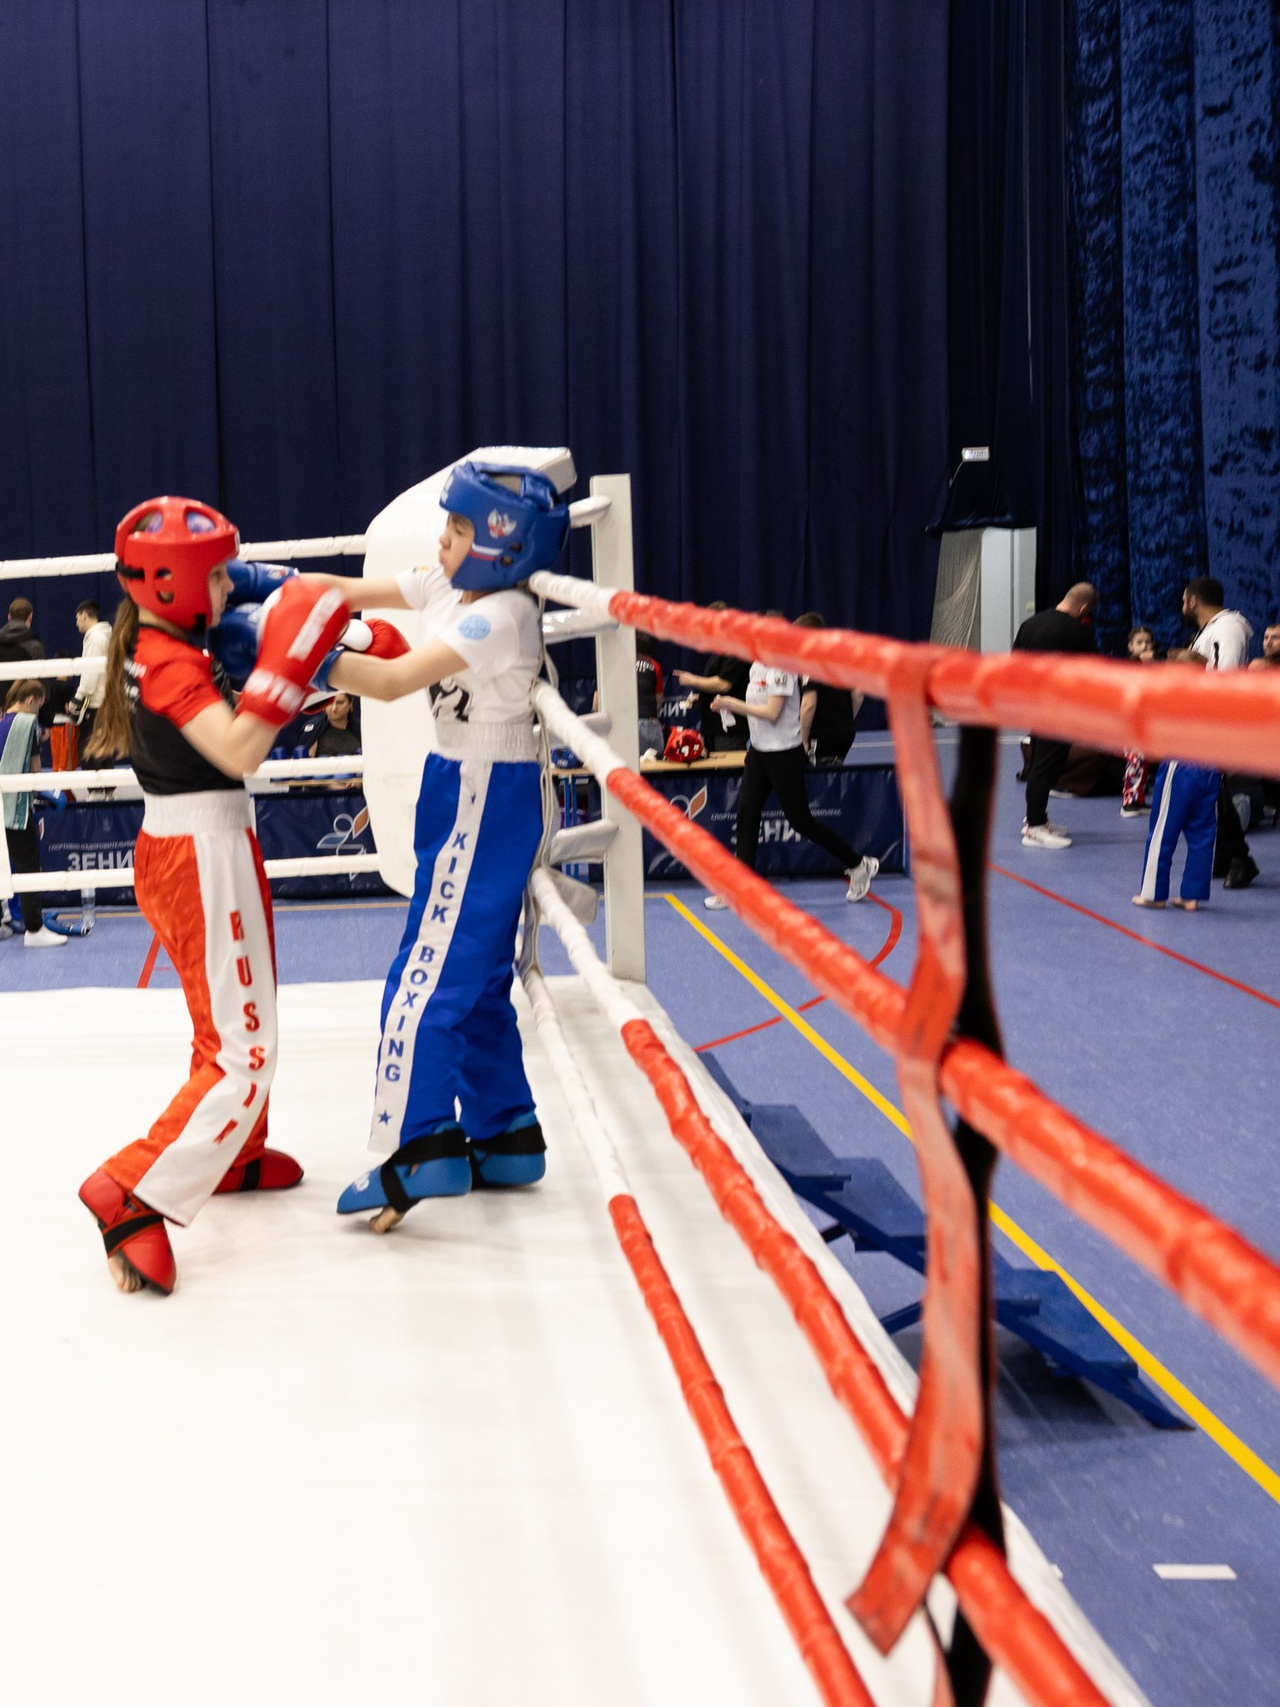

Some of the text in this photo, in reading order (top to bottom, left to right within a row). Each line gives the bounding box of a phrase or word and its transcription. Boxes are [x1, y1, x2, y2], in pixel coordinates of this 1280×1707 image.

[67, 849, 134, 871] ЗЕНИ
[439, 832, 468, 923] KICK
[384, 945, 435, 1083] BOXING
